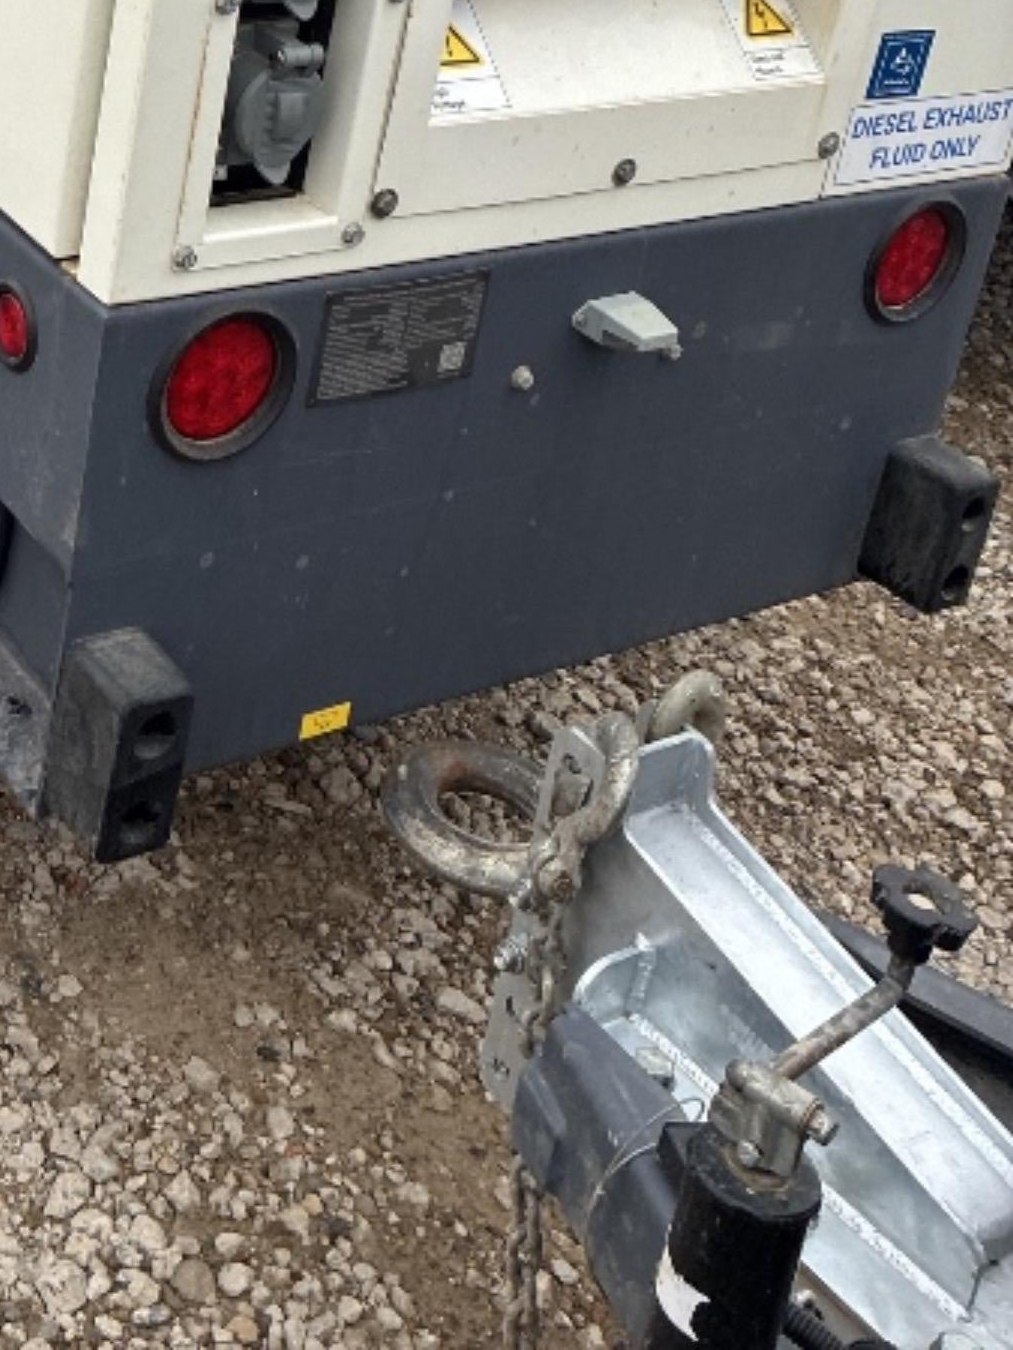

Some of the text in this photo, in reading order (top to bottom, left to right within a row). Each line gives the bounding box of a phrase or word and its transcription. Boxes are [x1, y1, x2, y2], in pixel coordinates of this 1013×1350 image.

[851, 98, 1013, 139] DIESEL EXHAUST
[869, 134, 982, 169] FLUID ONLY
